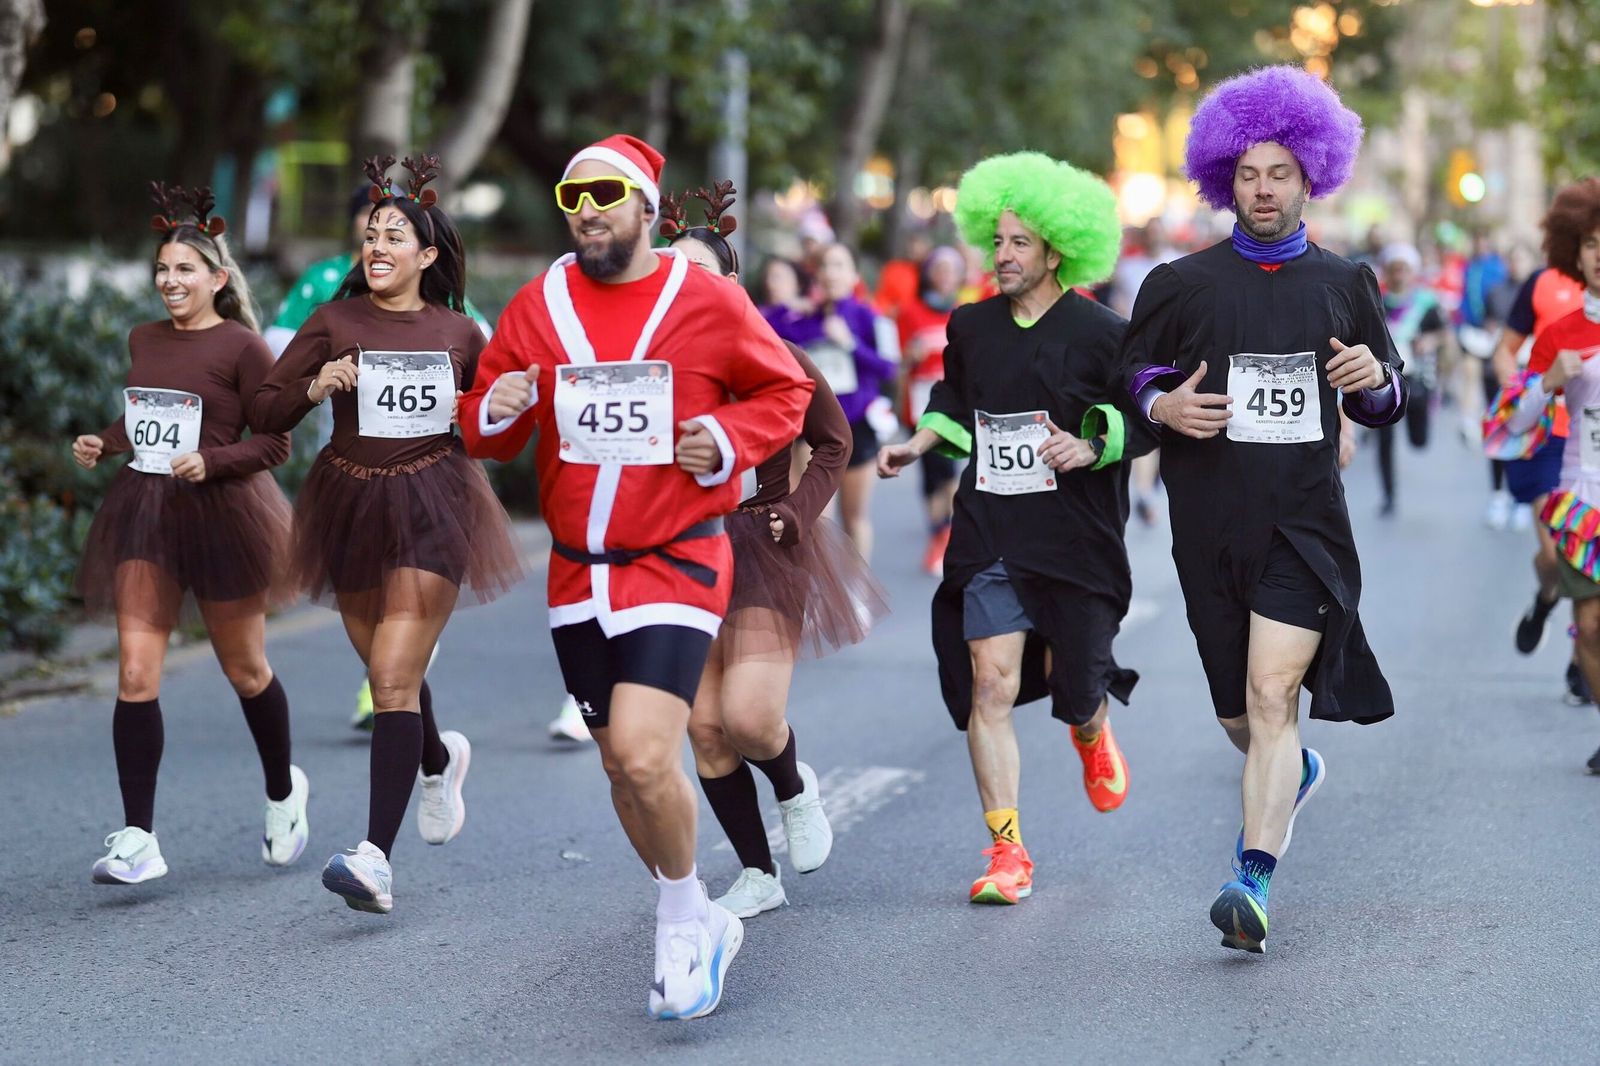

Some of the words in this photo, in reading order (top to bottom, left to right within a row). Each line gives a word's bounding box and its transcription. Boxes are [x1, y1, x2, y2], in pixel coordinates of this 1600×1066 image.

[377, 385, 437, 412] 465
[1246, 387, 1306, 417] 459
[577, 401, 649, 433] 455
[134, 420, 180, 449] 604
[988, 444, 1035, 471] 150
